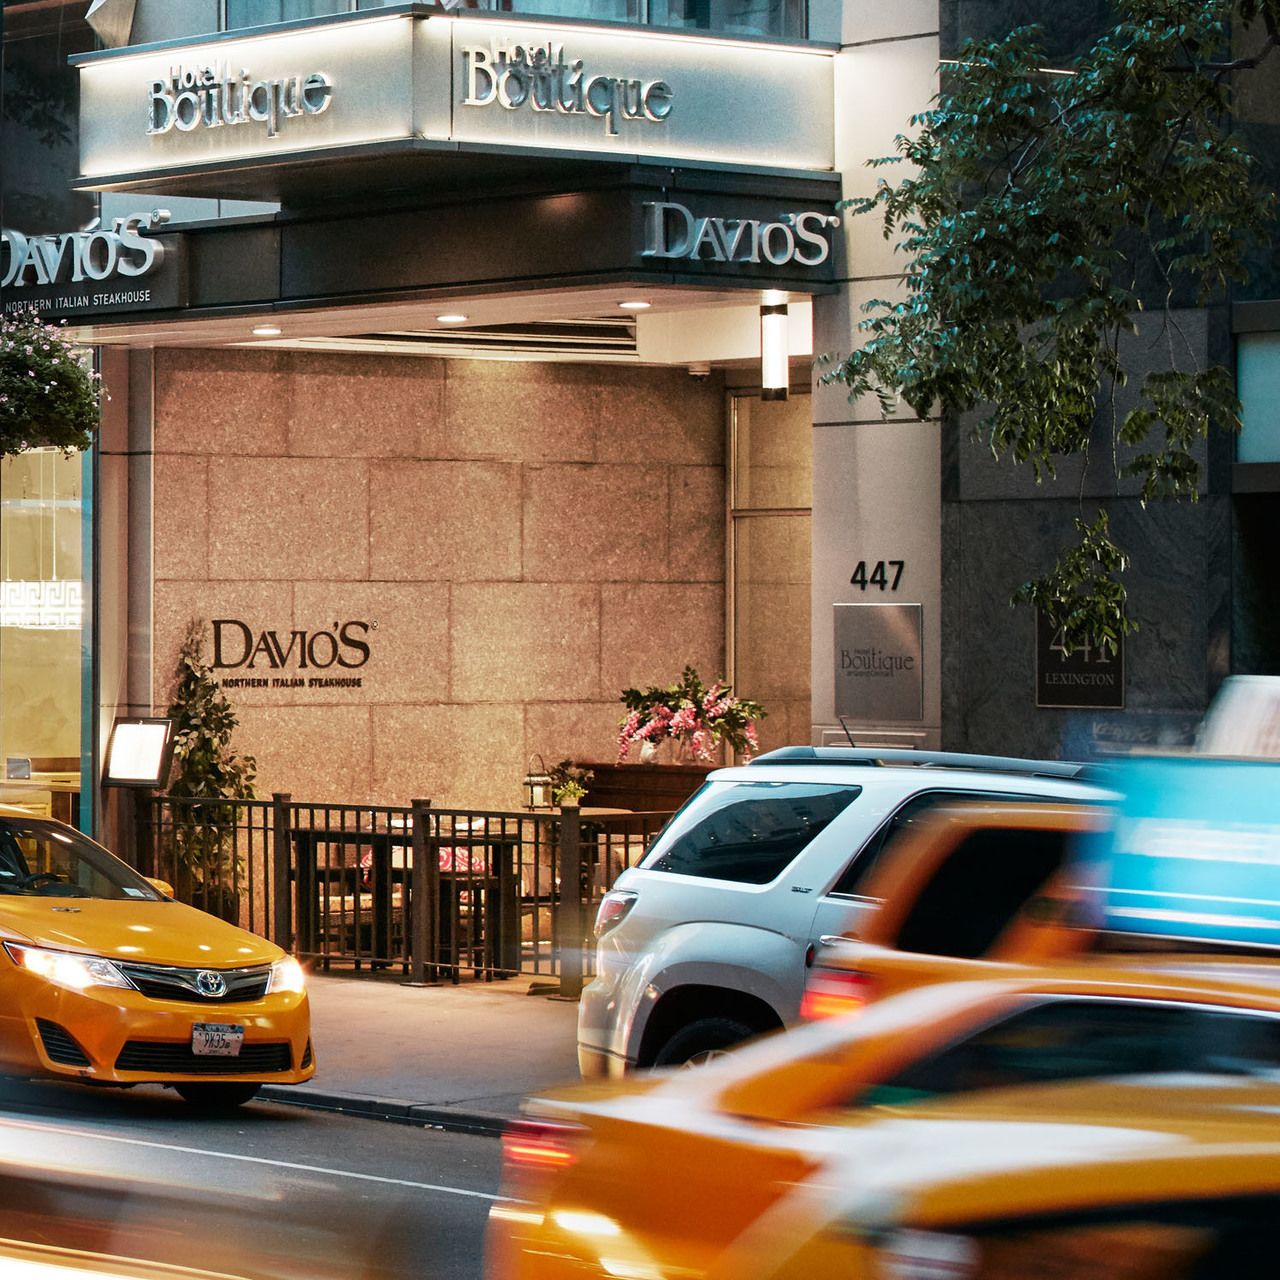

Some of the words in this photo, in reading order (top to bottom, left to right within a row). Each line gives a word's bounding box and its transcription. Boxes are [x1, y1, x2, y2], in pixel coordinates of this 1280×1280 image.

[170, 60, 221, 90] Hotel
[461, 43, 673, 137] Boutique
[145, 60, 334, 138] Boutique
[5, 298, 52, 313] NORTHERN
[55, 295, 89, 309] ITALIAN
[93, 289, 151, 306] STEAKHOUSE
[850, 560, 905, 592] 447
[841, 647, 914, 677] Boutique
[222, 678, 269, 688] NORTHERN
[272, 678, 305, 688] ITALIAN
[308, 678, 362, 688] STEAKHOUSE
[1045, 672, 1115, 686] LEXINGTON
[204, 1032, 226, 1048] 9K35
